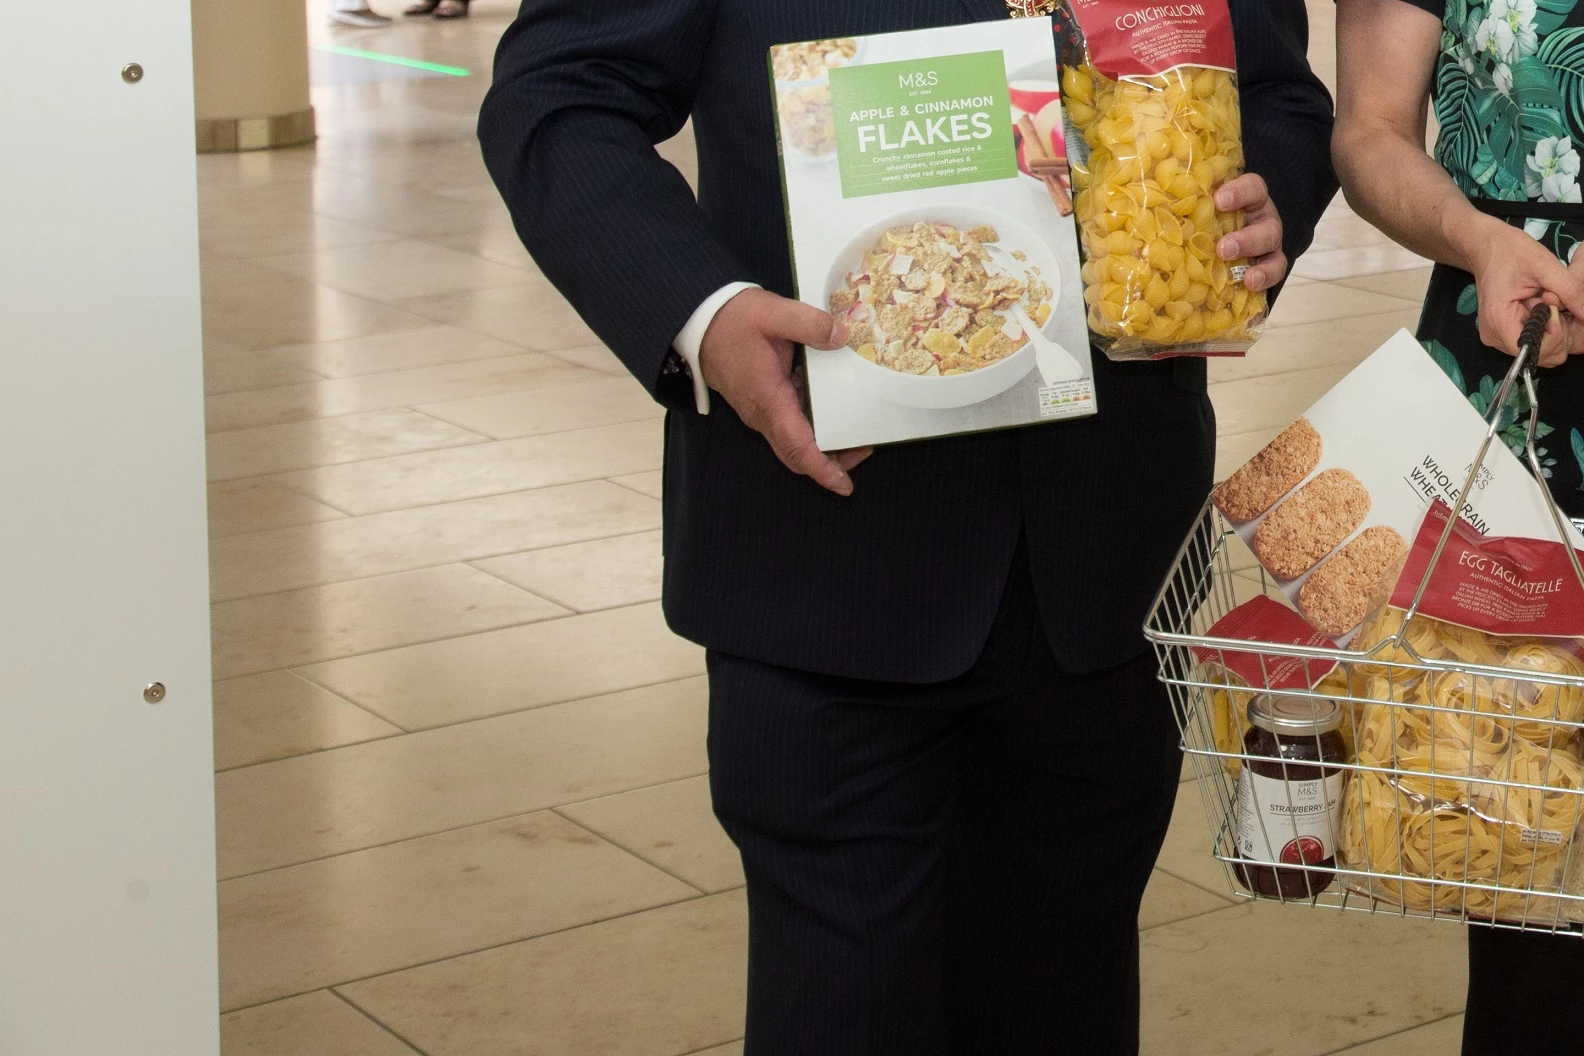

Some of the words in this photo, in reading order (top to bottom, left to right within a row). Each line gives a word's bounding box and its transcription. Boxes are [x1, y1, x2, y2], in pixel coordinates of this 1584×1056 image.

[1115, 4, 1205, 31] CONCHIGLIONI
[1131, 24, 1162, 37] AUTHENTIC
[1163, 20, 1182, 29] ITALIAN
[899, 71, 938, 89] M&S
[850, 107, 895, 122] APPLE
[901, 106, 909, 116] &
[915, 96, 993, 115] CINNAMON
[858, 112, 992, 153] FLAKES
[872, 155, 900, 164] Crunchy
[903, 150, 935, 160] cinnamon
[938, 148, 960, 156] coated
[930, 157, 963, 166] cornflakes
[936, 168, 954, 176] apple
[957, 165, 978, 174] pieces
[1479, 463, 1495, 481] MPLY
[1422, 455, 1490, 535] WHOLERAIN
[1459, 551, 1487, 571] EGG
[1490, 561, 1563, 594] TAGLIATELLE
[1469, 572, 1503, 589] AUTHENTIC
[1503, 585, 1525, 601] ITALIAN
[1298, 787, 1318, 796] M&S
[1324, 799, 1336, 809] AM
